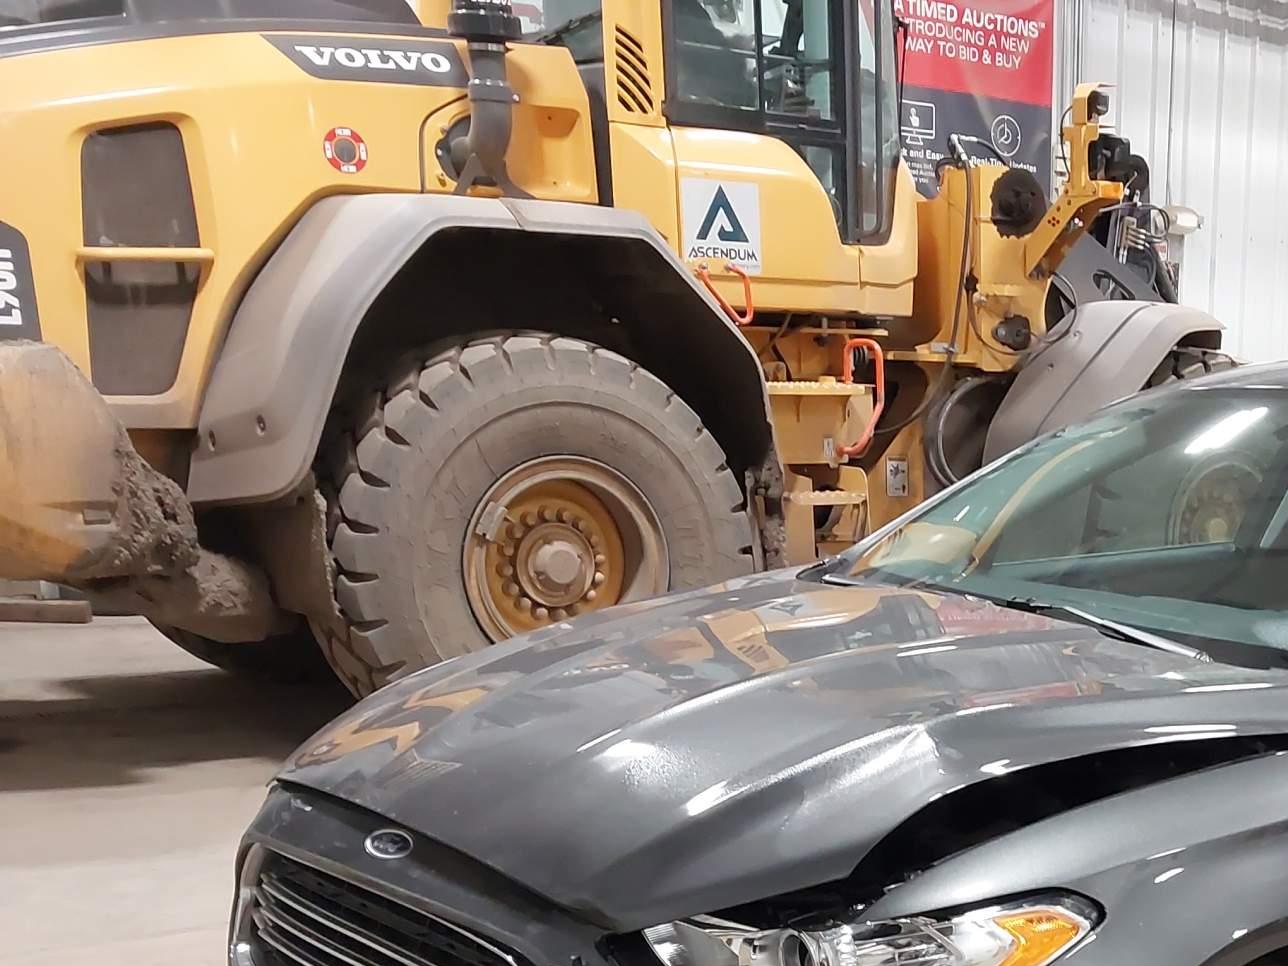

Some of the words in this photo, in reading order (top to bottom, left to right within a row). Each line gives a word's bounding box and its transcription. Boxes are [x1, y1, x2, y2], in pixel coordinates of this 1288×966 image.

[908, 0, 958, 22] TIMED
[900, 17, 985, 46] TRODUCING
[988, 34, 997, 48] A
[1000, 35, 1030, 54] NEW
[295, 45, 451, 73] VOLVO
[937, 40, 956, 58] TO
[959, 46, 979, 62] BID
[982, 51, 992, 65] &
[995, 52, 1022, 69] BUY
[909, 149, 924, 159] and
[688, 246, 757, 261] ASCENDUM
